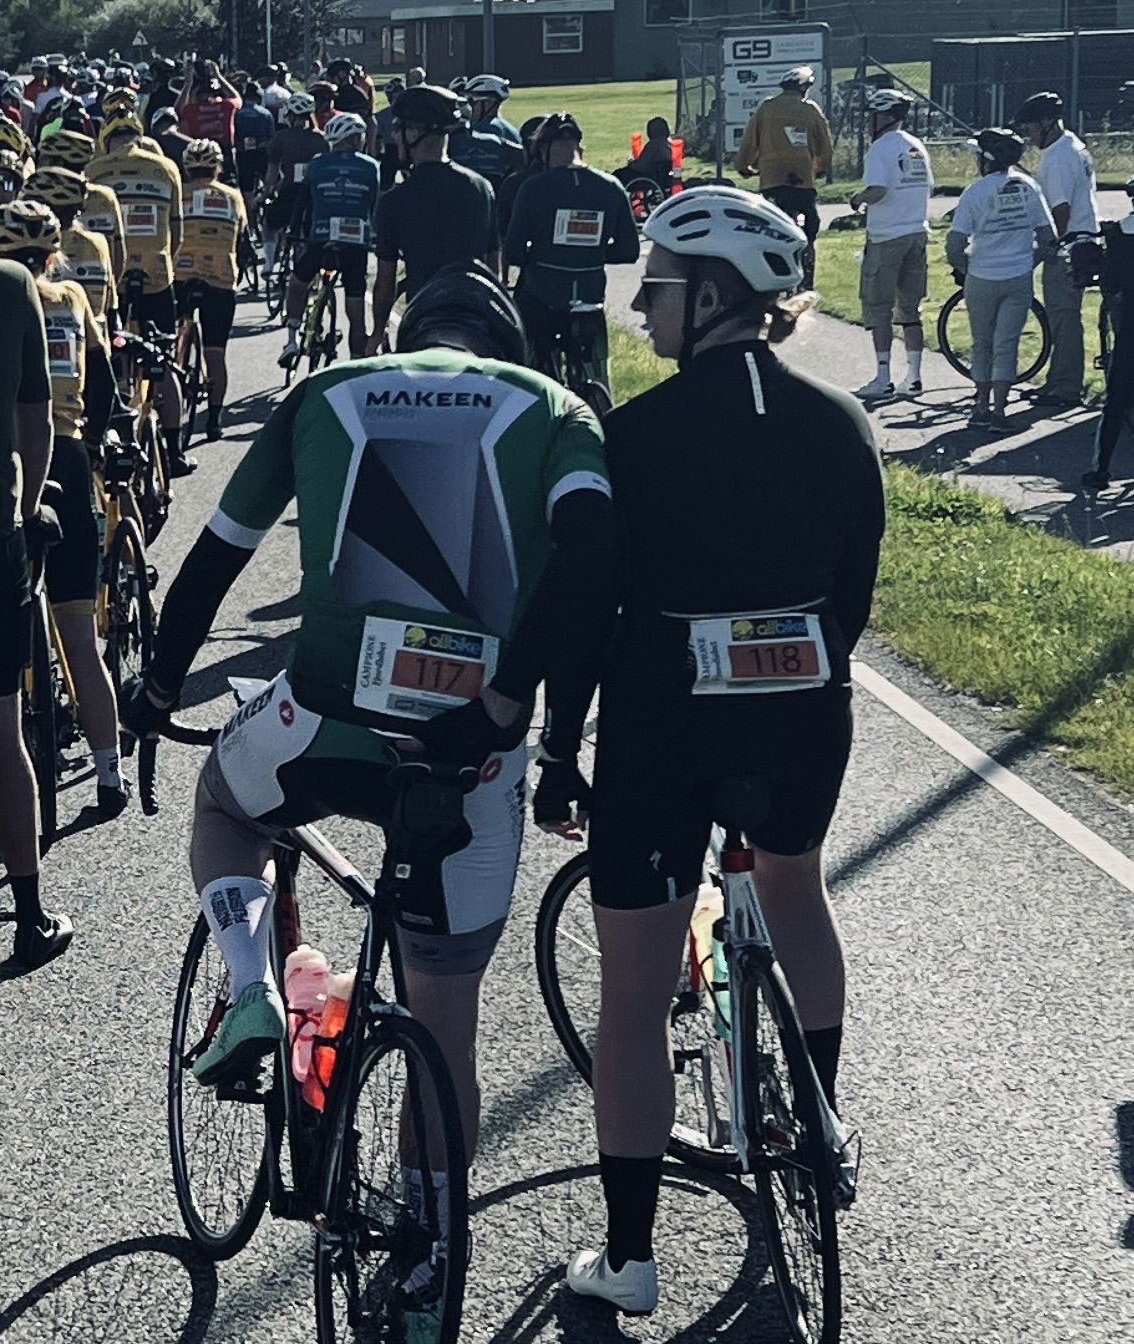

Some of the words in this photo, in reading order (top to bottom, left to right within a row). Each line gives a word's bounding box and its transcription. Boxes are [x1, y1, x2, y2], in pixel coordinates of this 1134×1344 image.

[732, 39, 772, 60] G9
[366, 391, 492, 408] MAKEEN
[429, 633, 482, 653] allbike
[360, 635, 376, 689] CAMPIONE
[749, 646, 802, 673] 118
[416, 658, 465, 691] 117
